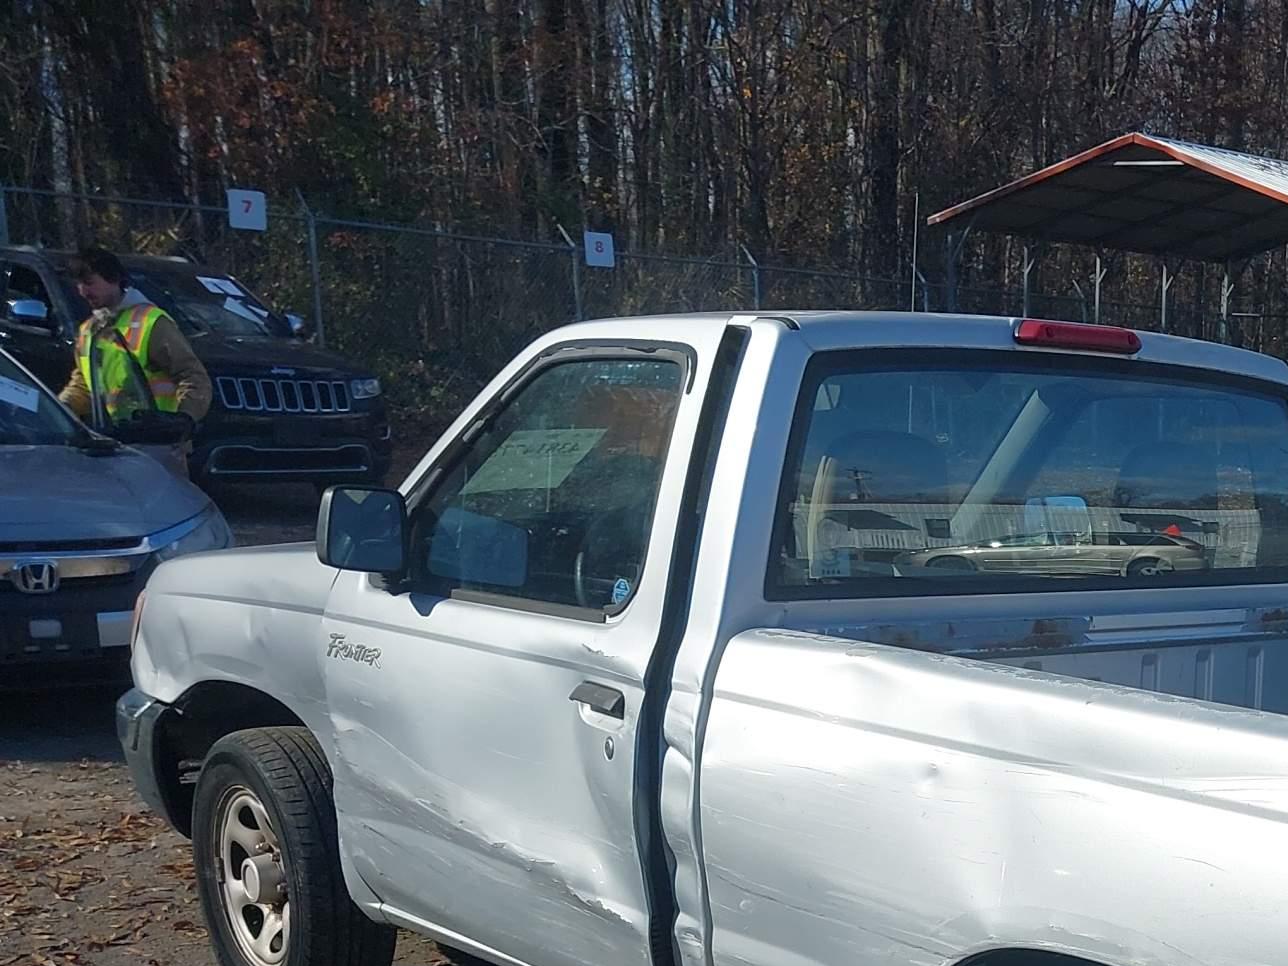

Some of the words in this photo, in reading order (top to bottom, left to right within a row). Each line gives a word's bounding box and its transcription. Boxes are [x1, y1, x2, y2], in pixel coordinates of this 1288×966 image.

[241, 199, 252, 214] 7
[595, 240, 604, 253] 8
[326, 632, 382, 670] FRONTIER
